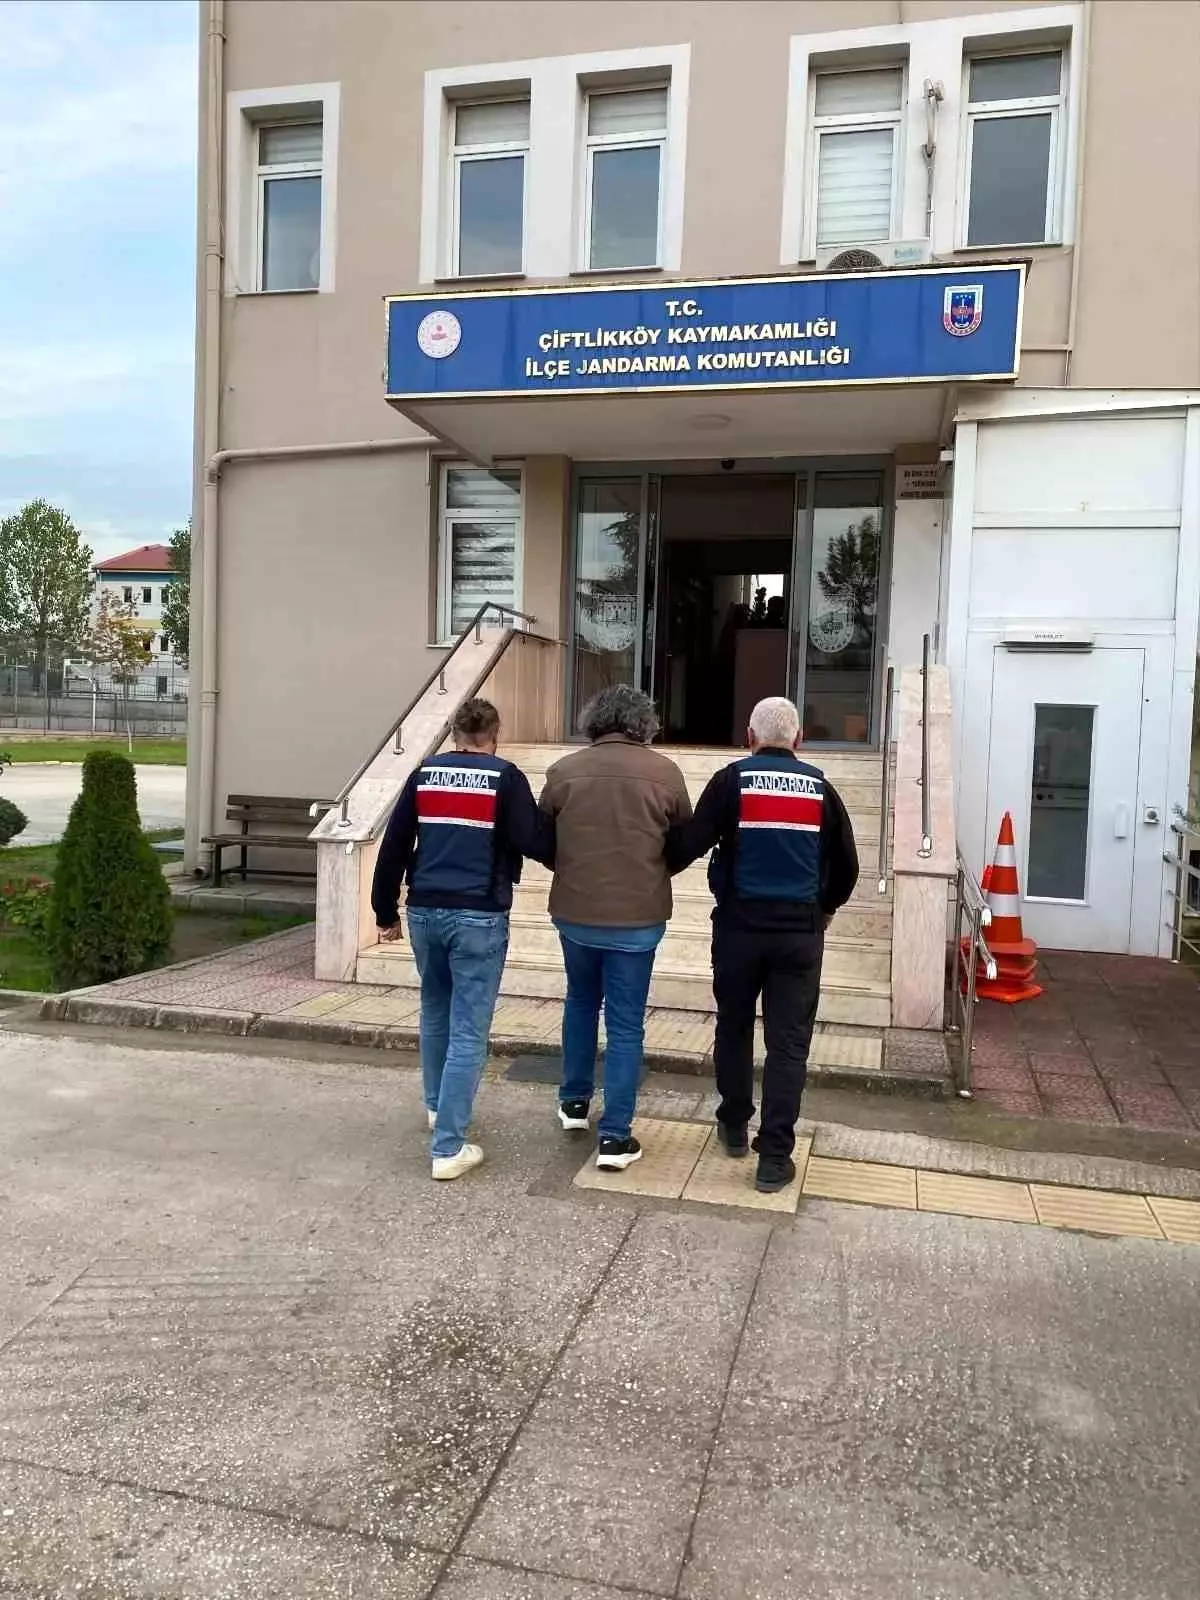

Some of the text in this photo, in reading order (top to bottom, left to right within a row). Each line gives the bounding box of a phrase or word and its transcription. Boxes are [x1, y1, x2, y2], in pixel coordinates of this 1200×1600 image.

[665, 300, 703, 317] T.C.
[538, 317, 838, 353] ÇİFTLİKKÖY KAYMAKAMLIĞI
[525, 345, 851, 380] İLÇE JANDARMA KOMUTANLIĞI
[425, 771, 490, 789] JANDARMA
[749, 775, 817, 794] JANDARMA
